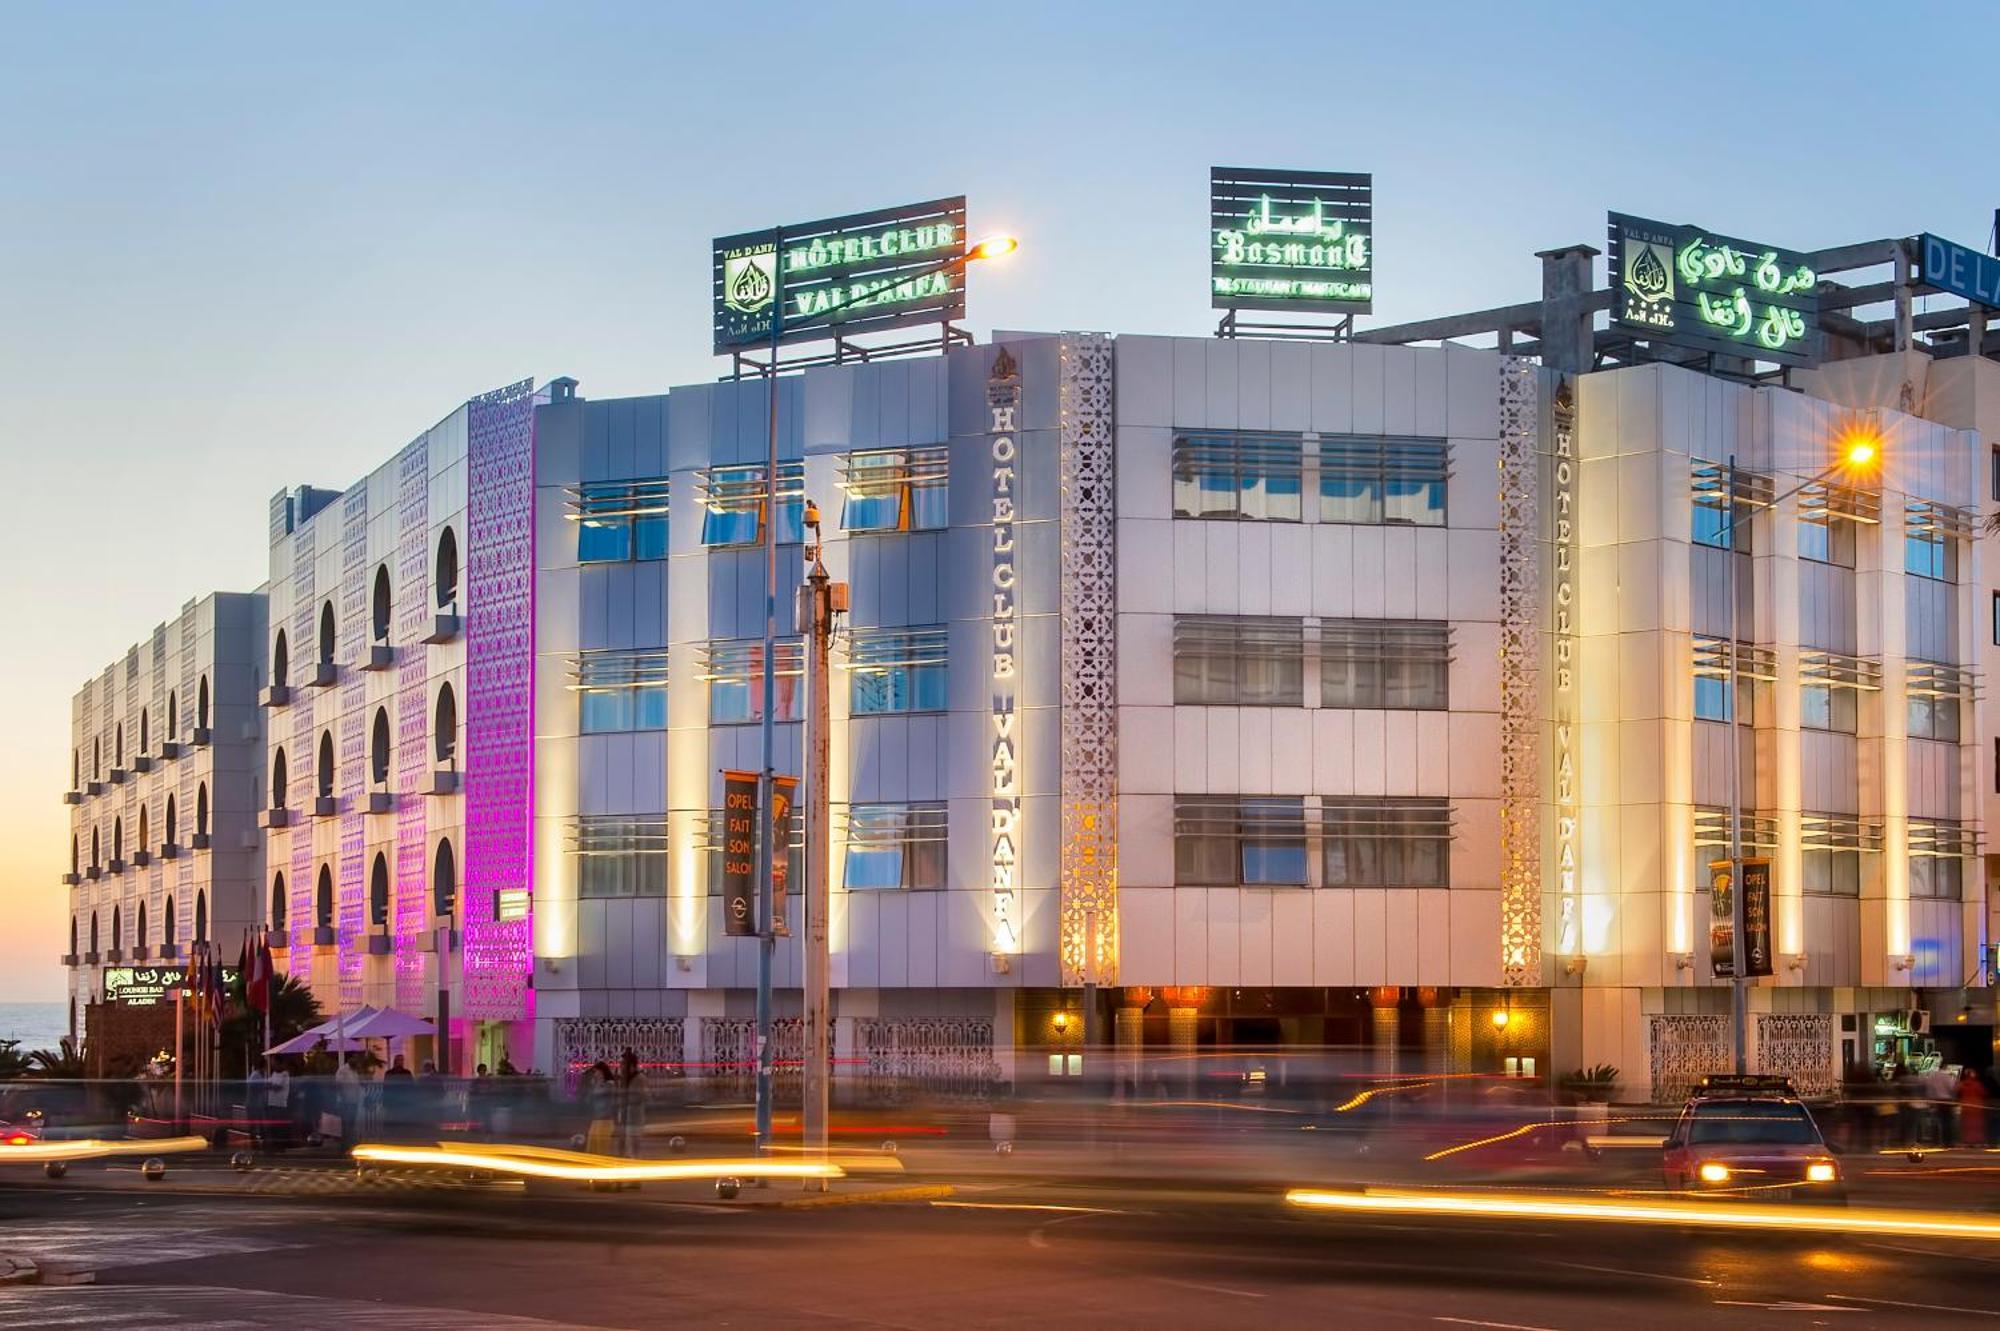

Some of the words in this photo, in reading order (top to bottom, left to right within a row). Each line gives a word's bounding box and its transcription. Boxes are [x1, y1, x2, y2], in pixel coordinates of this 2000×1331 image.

[724, 248, 742, 260] VAL
[789, 235, 878, 272] HÔTEL
[880, 222, 953, 255] CLUB
[1678, 237, 1746, 284] نادي
[1926, 236, 1966, 290] DE
[1757, 251, 1815, 294] فندق
[795, 287, 846, 314] VAL
[992, 407, 1015, 552] HOTEL
[1557, 434, 1573, 572] HOTEL
[992, 563, 1015, 679] CLUB
[1557, 583, 1573, 693] CLUB
[992, 713, 1015, 796] VAL
[1558, 726, 1574, 806] VAL
[727, 793, 754, 810] OPEL
[729, 818, 750, 833] FAIT
[729, 839, 751, 854] SON
[1745, 874, 1766, 885] OPEL
[119, 986, 148, 995] LOUNGE
